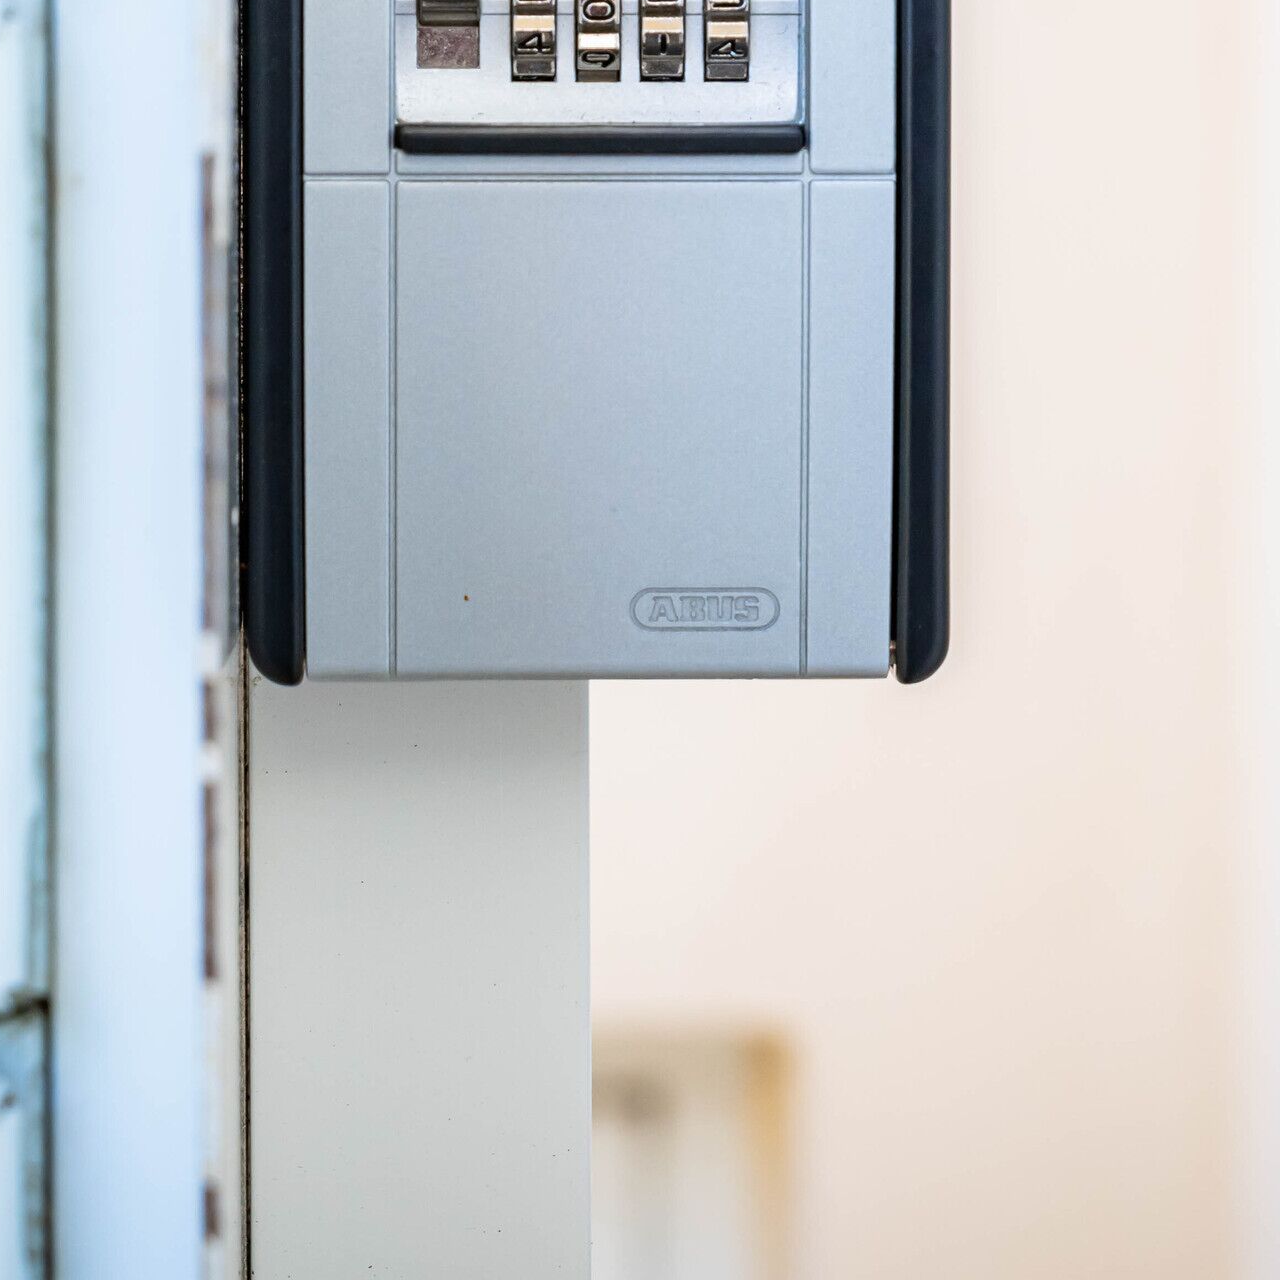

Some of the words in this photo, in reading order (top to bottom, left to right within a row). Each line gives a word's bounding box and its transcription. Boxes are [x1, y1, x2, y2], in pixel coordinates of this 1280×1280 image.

[516, 32, 551, 55] 4
[710, 39, 745, 60] 4
[648, 595, 760, 622] ABUS
